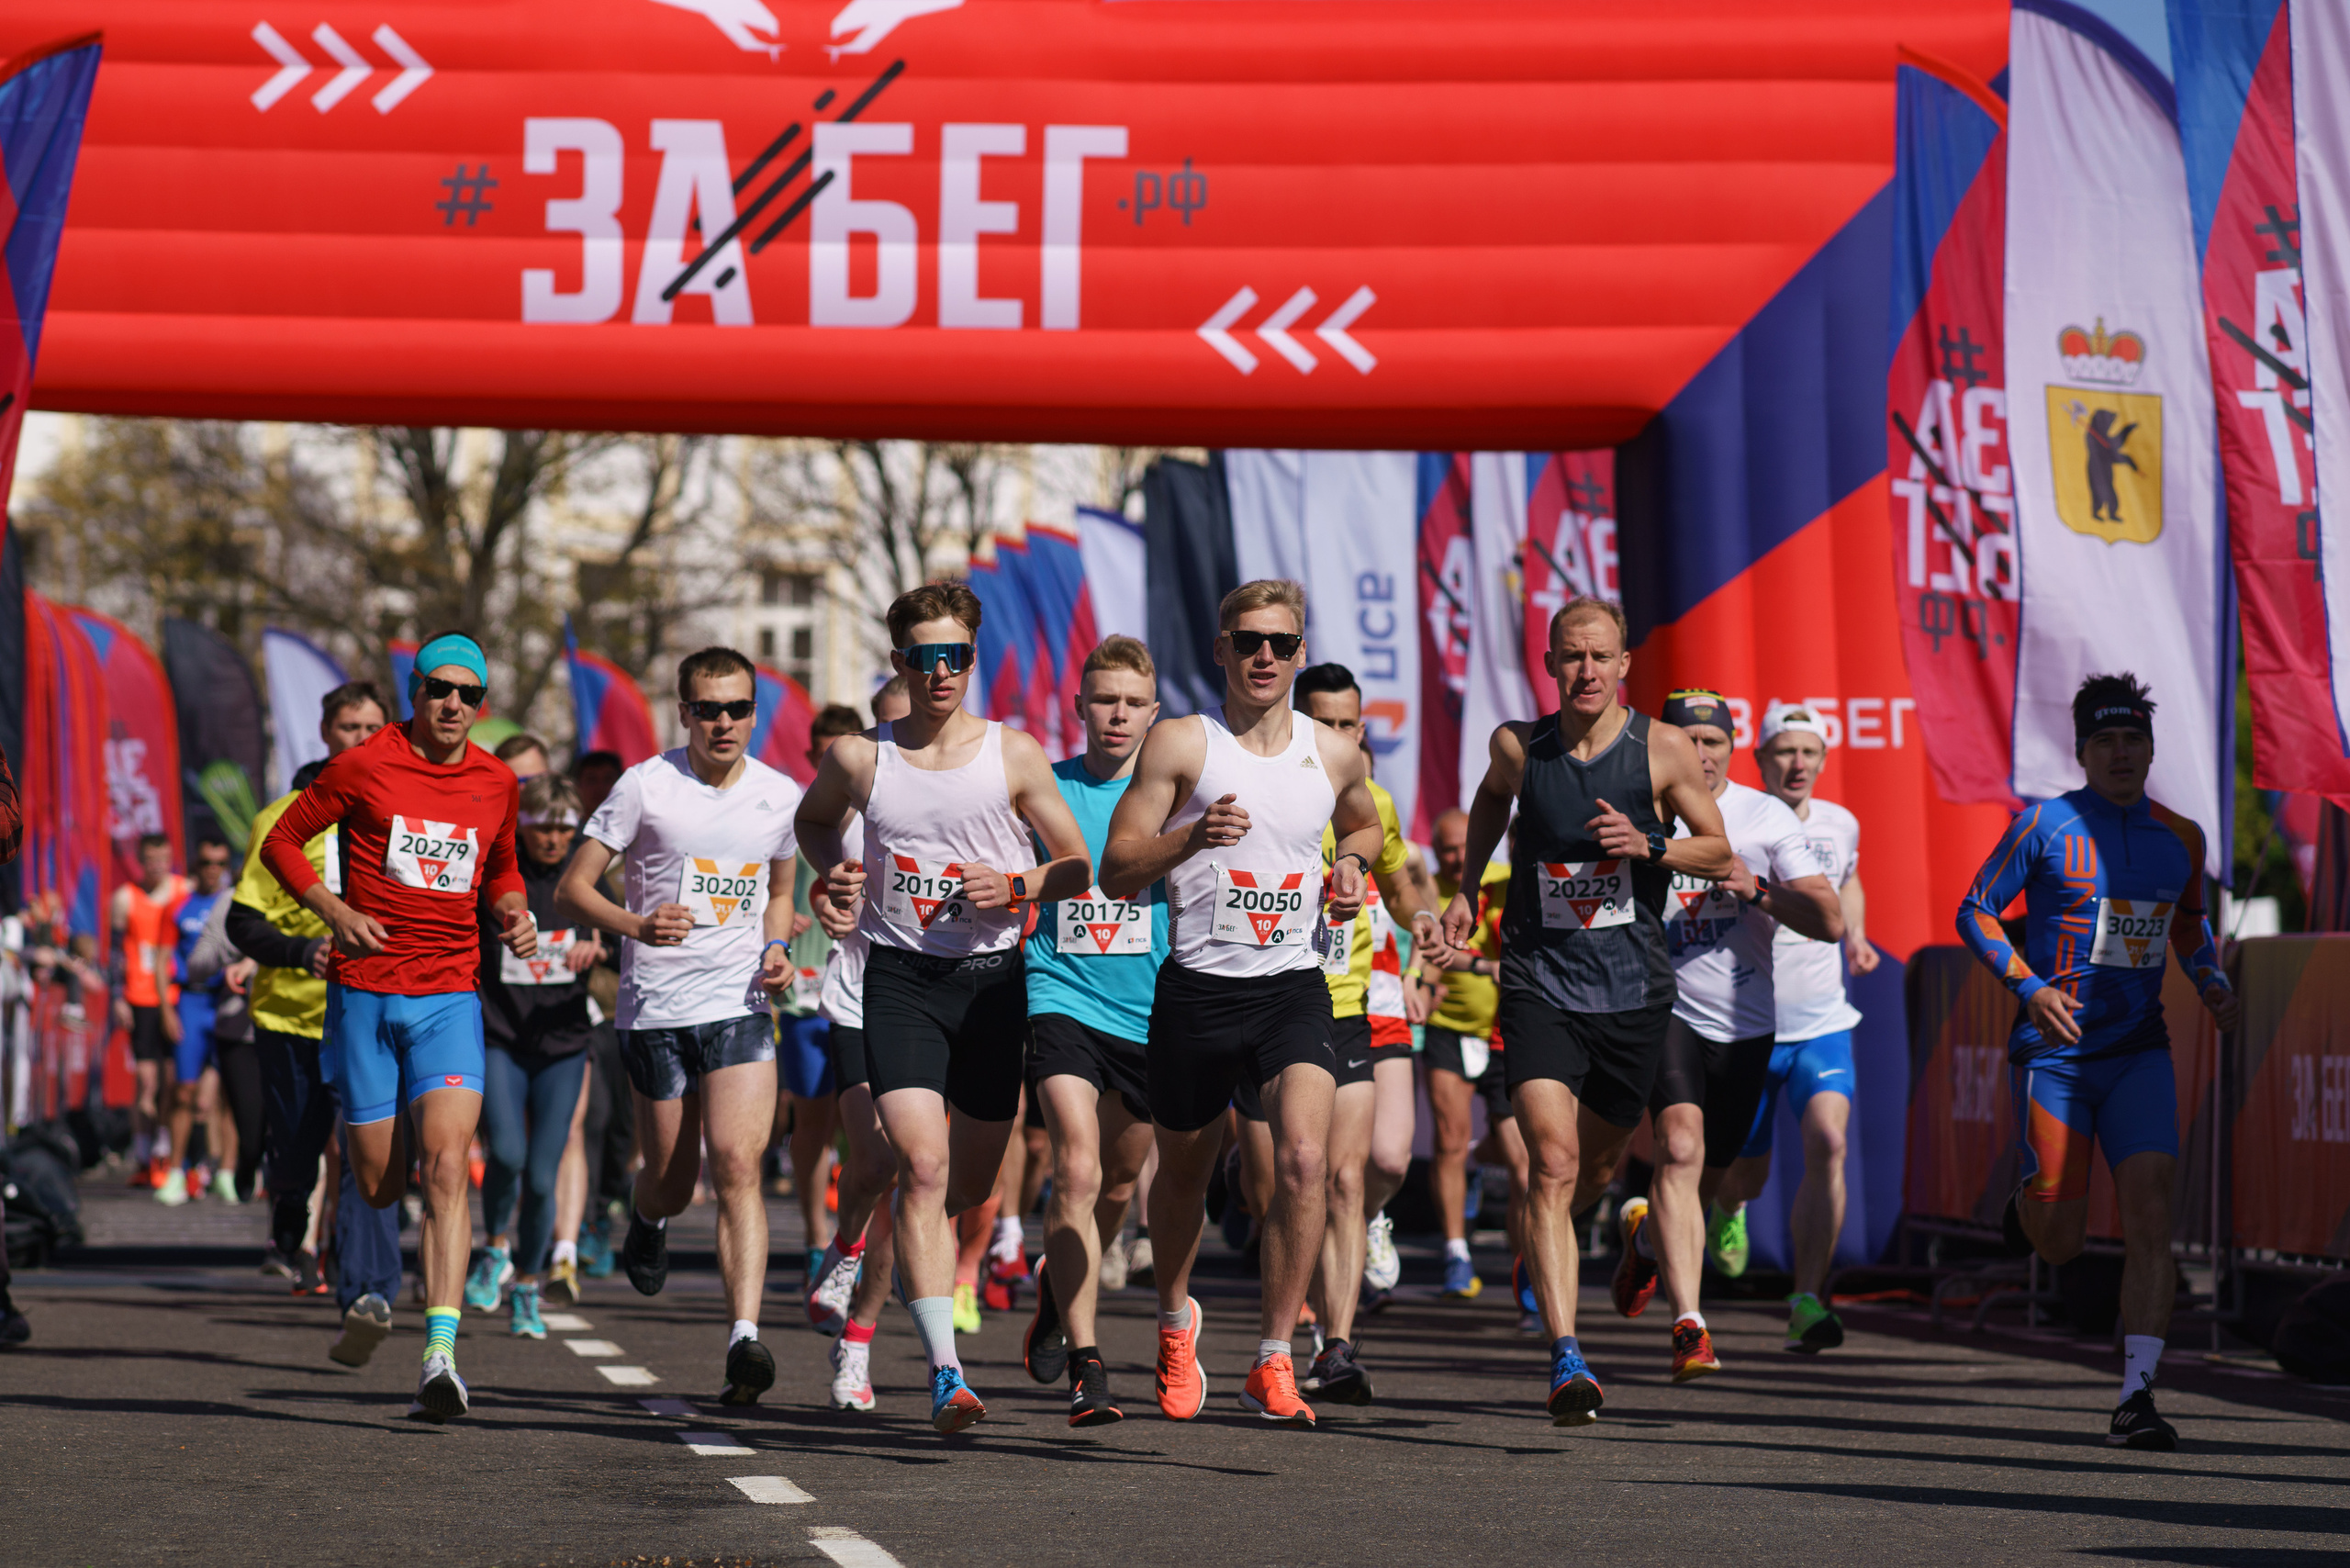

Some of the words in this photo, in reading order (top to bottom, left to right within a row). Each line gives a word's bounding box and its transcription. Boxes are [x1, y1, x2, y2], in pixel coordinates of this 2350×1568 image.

[399, 835, 469, 860] 20279
[423, 864, 438, 875] 10
[691, 875, 756, 896] 30202
[892, 872, 968, 901] 20192
[1548, 876, 1620, 898] 20229
[919, 904, 934, 916] 10
[1226, 889, 1302, 912] 20050
[1578, 905, 1593, 915] 10
[1067, 902, 1140, 922] 20175
[1095, 929, 1111, 940] 10
[1256, 919, 1271, 931] 10
[2107, 916, 2165, 937] 30223
[956, 955, 1003, 971] PRO
